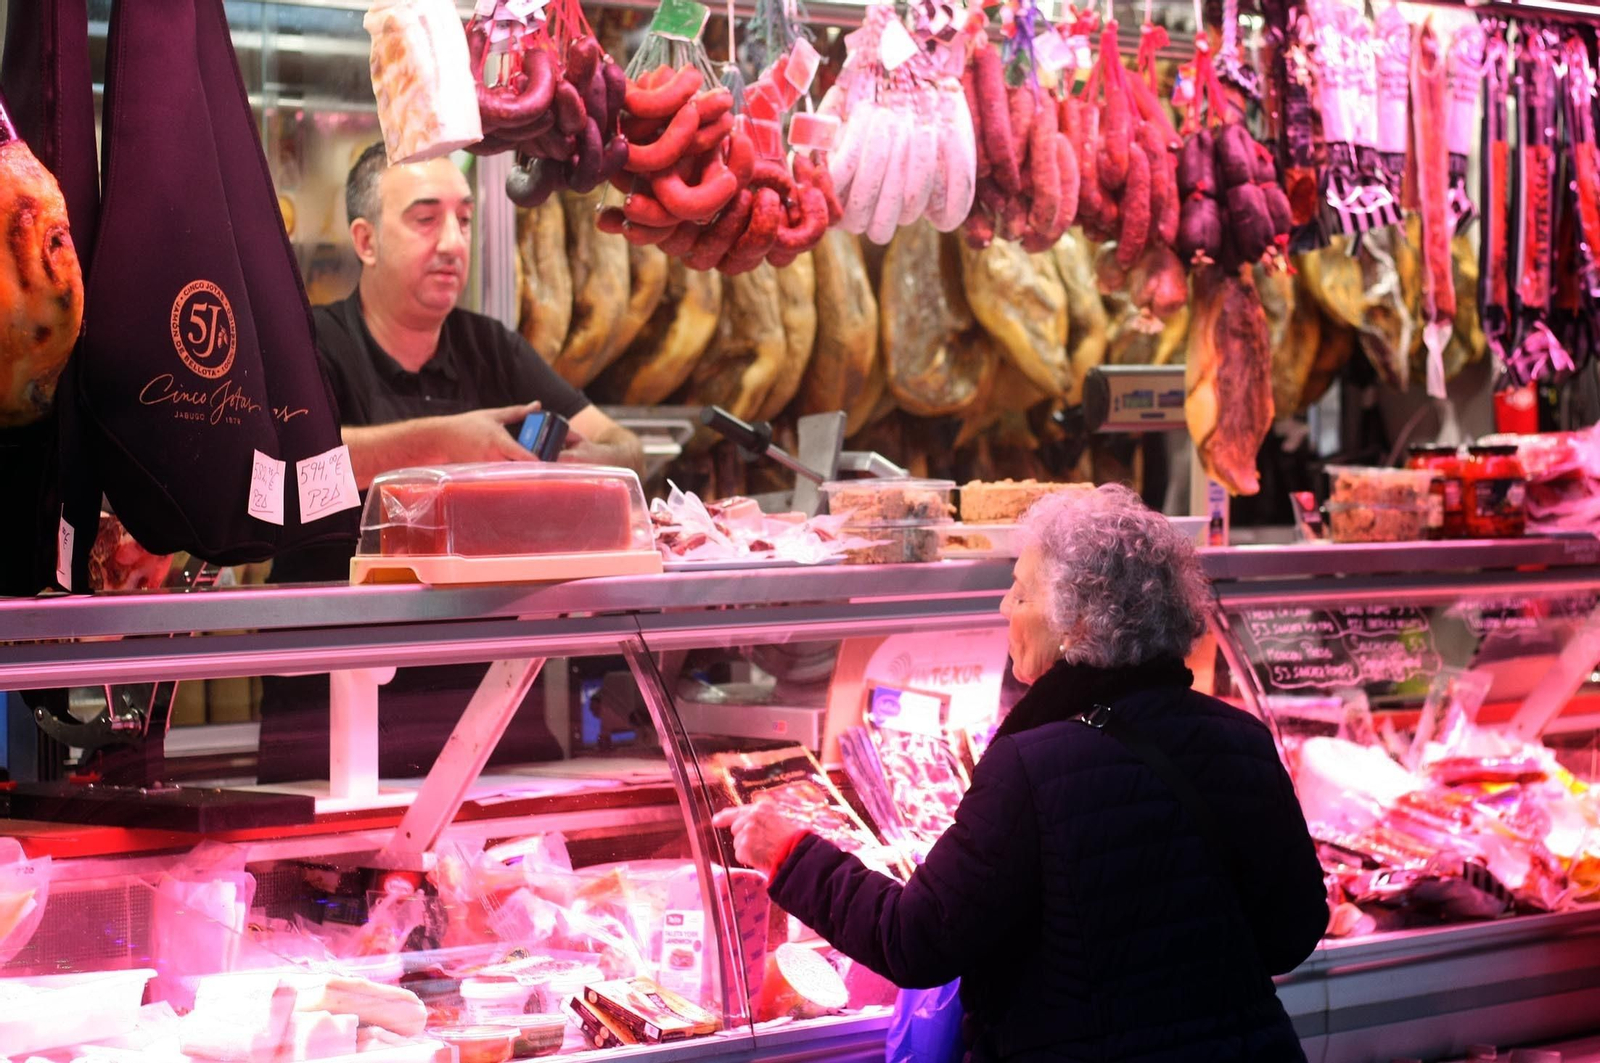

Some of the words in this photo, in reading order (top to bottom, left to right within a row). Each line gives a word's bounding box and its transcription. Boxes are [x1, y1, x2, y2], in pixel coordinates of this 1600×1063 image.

[183, 282, 205, 296] CINCO
[206, 282, 225, 301] JOTAS
[172, 302, 180, 337] JAMÓN
[176, 341, 185, 353] DE
[184, 355, 217, 376] BELLOTA
[187, 302, 222, 358] 5J
[139, 373, 207, 405] Cinco
[209, 379, 261, 426] Jotas
[174, 410, 205, 421] JABUGO
